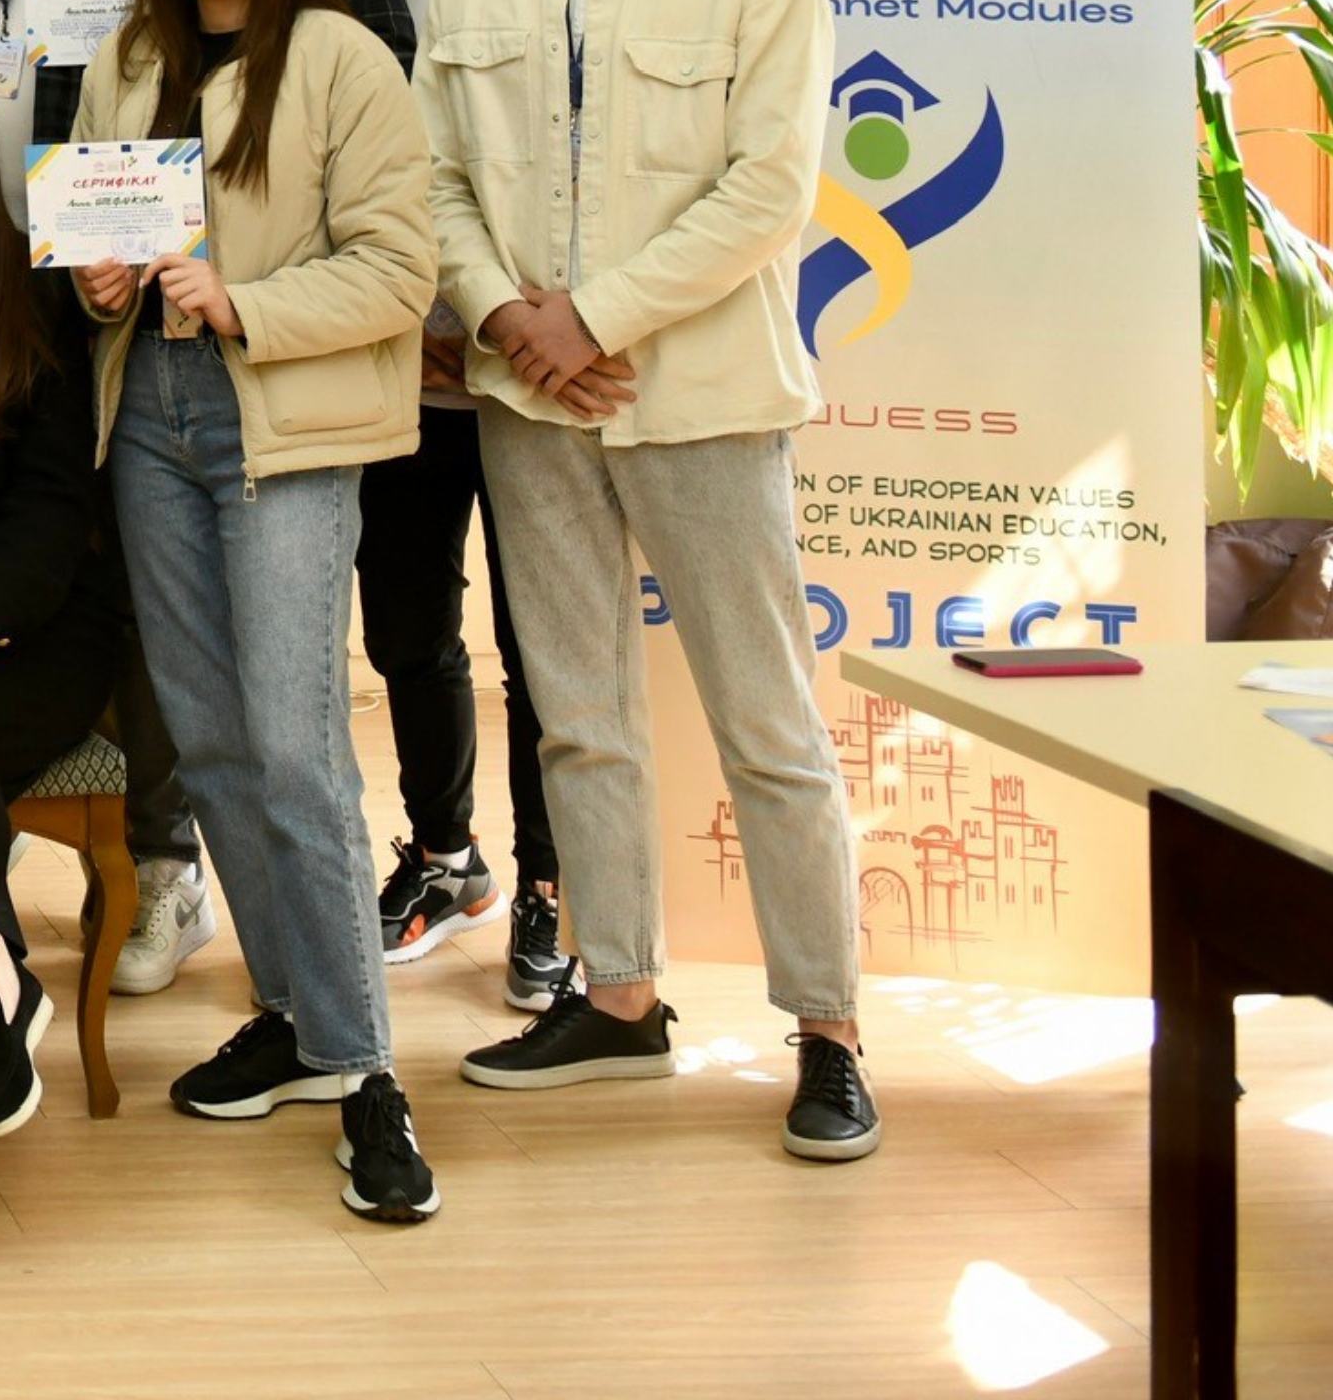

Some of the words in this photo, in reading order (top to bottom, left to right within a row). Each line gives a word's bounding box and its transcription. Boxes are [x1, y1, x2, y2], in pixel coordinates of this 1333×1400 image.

[826, 474, 863, 495] OF
[873, 476, 1020, 504] EUROPEAN
[1029, 485, 1136, 510] VALUES
[803, 503, 839, 524] OF
[849, 506, 993, 534] UKRAINIAN
[1002, 514, 1169, 547] EDUCATION,
[861, 537, 918, 559] AND
[928, 542, 1042, 567] SPORTS
